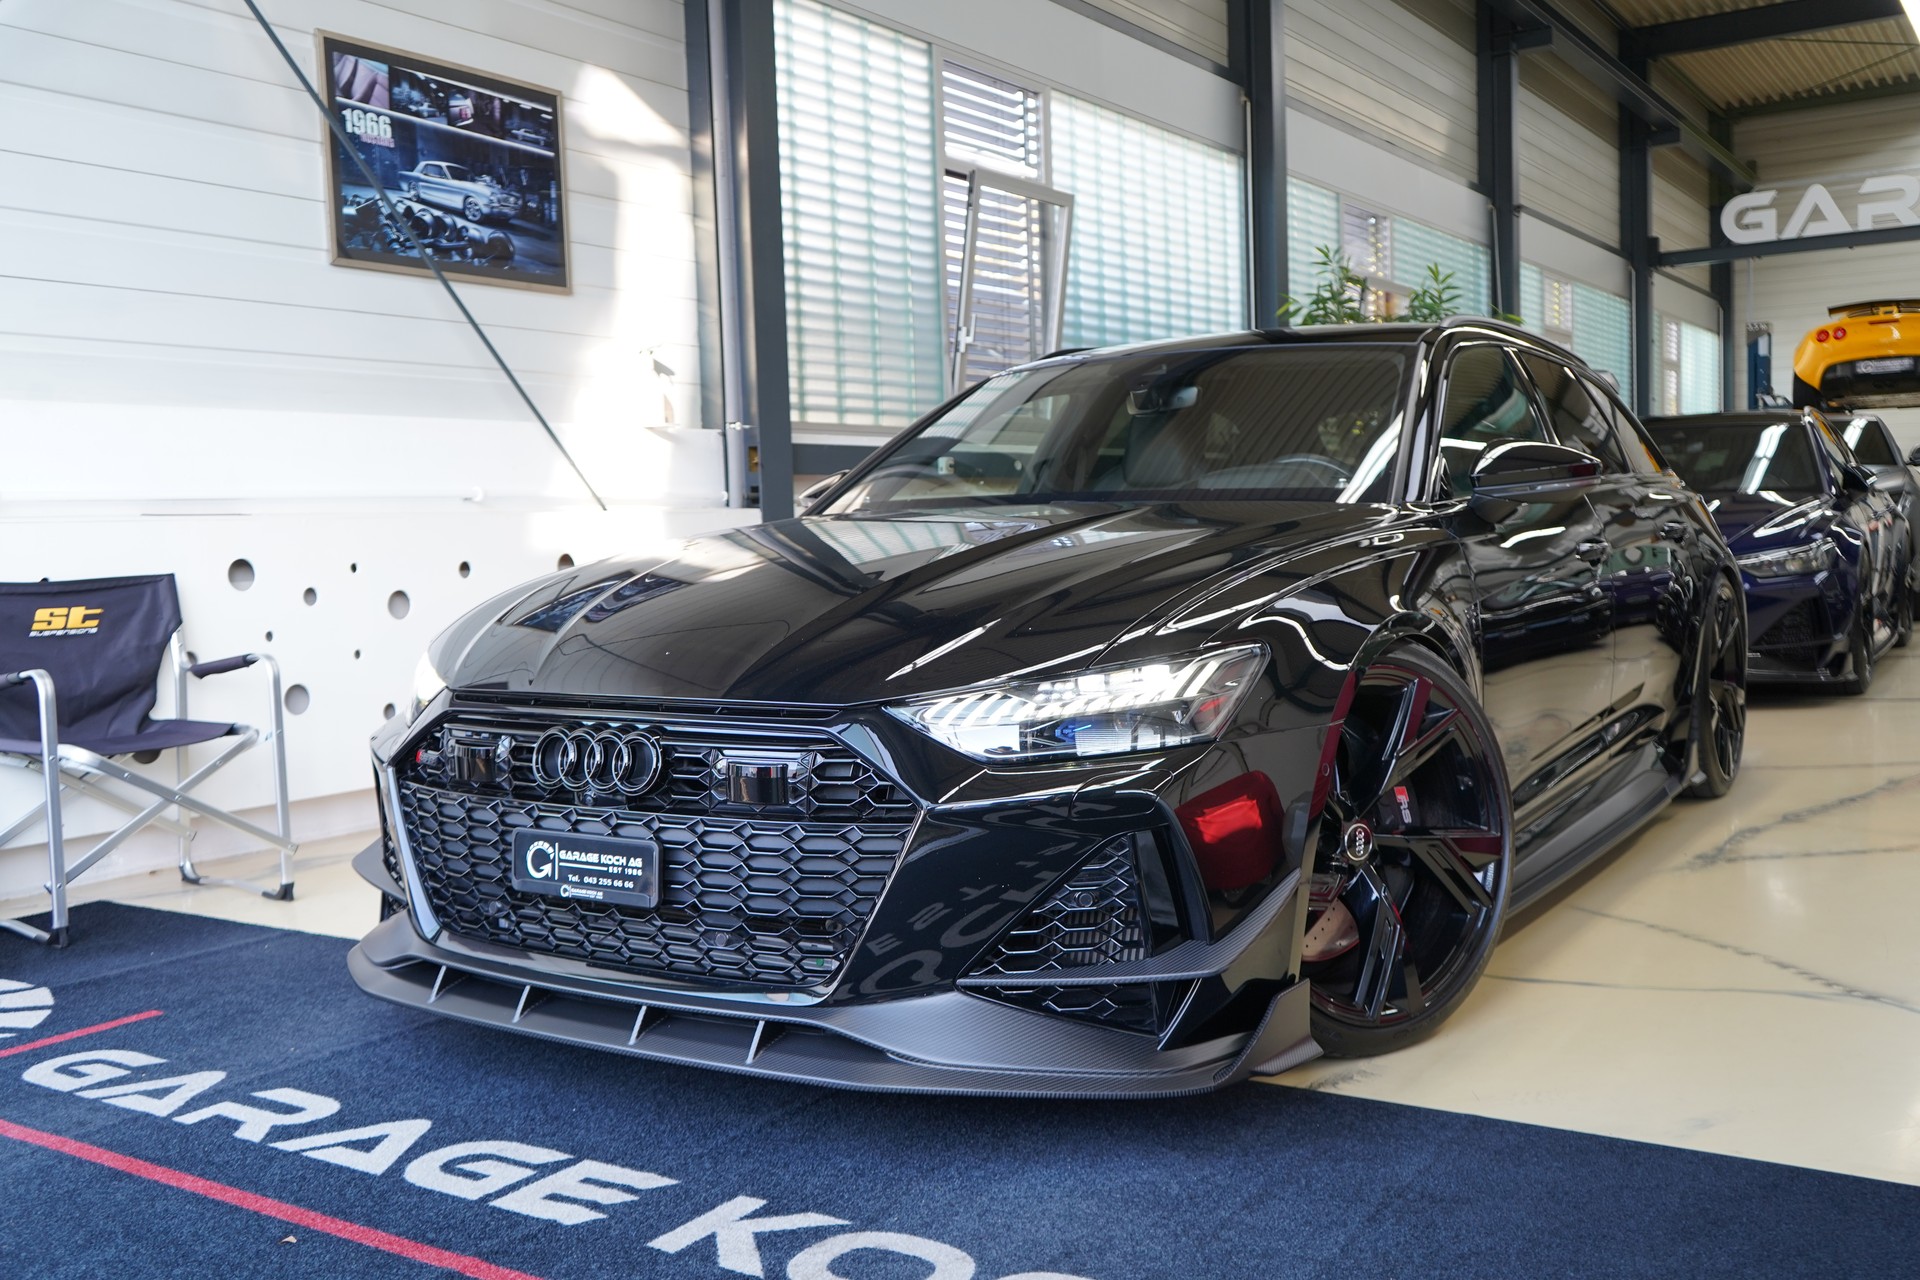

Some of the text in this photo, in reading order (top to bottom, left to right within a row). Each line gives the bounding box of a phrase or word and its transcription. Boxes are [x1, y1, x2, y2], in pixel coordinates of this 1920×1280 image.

[341, 107, 392, 138] 1966
[1720, 174, 1920, 244] GAR
[1396, 793, 1412, 824] RS
[559, 849, 643, 868] GARAGE KOCH AG
[568, 874, 634, 889] Tel. 043 255 66 66
[21, 1048, 1098, 1280] GARAGE KO
